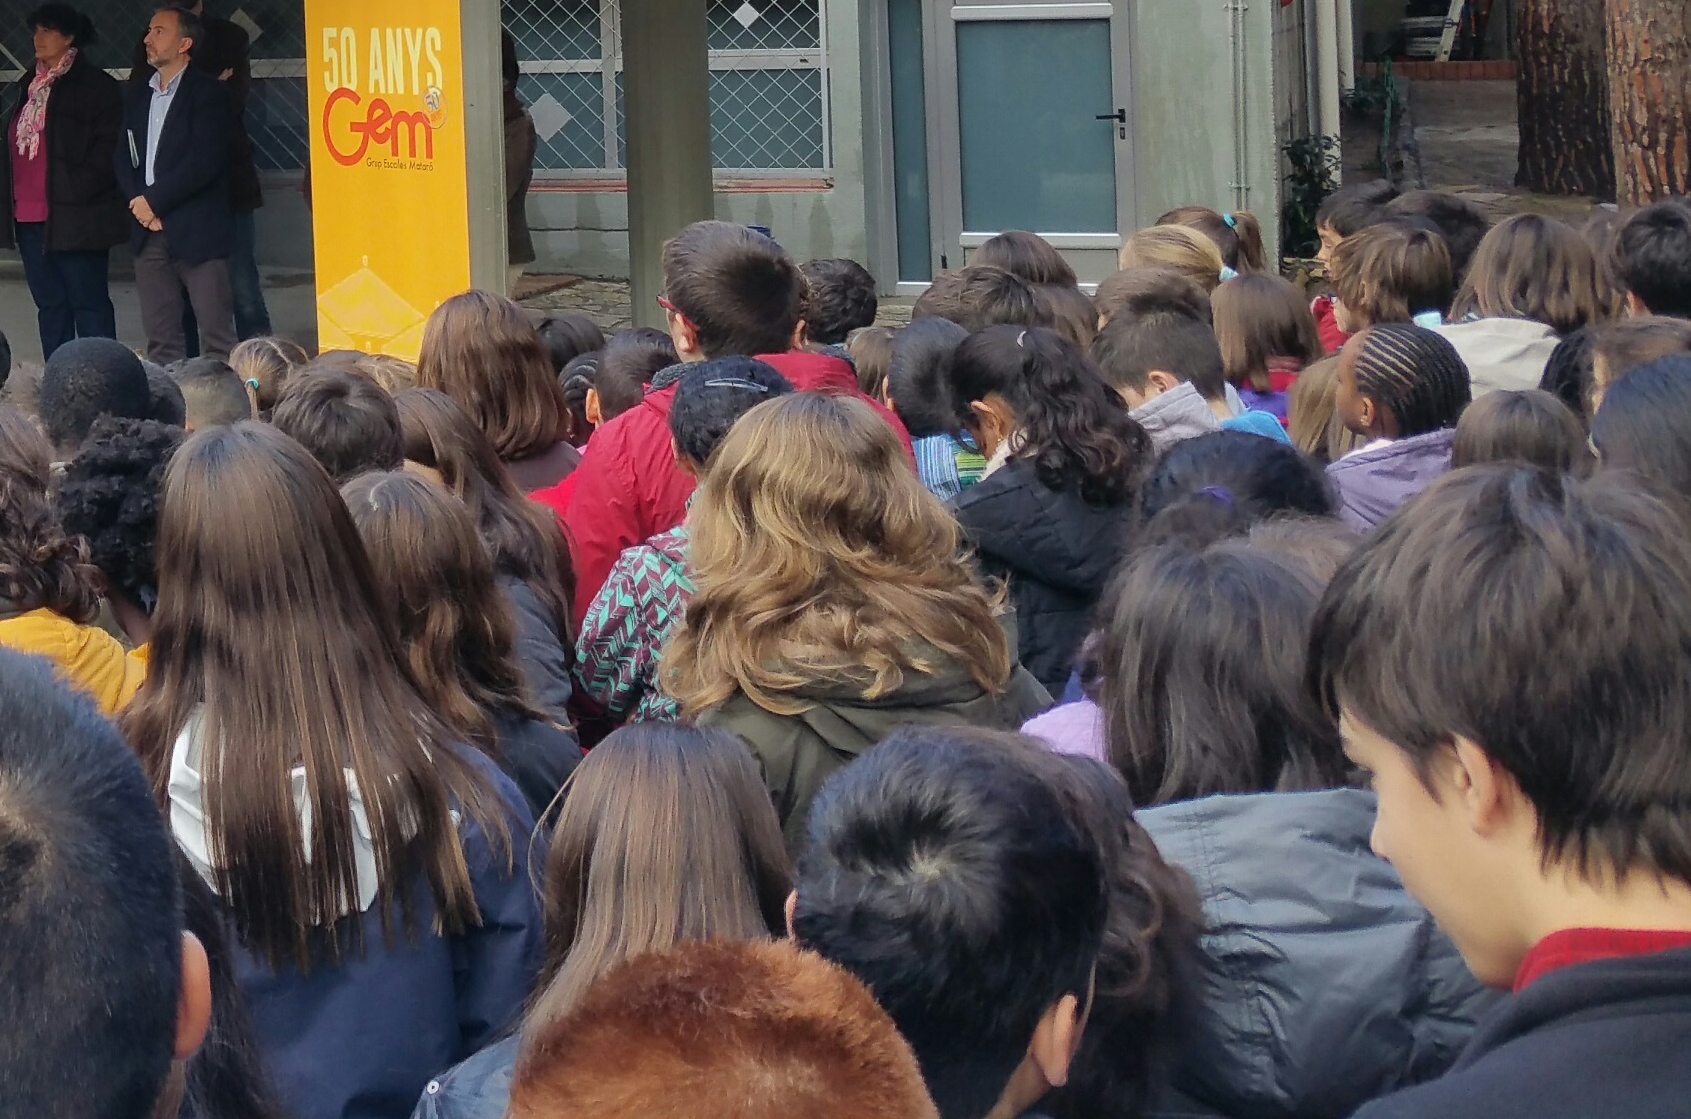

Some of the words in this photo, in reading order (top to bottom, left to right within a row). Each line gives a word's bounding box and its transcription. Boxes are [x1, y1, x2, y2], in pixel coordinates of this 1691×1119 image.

[323, 26, 359, 93] 50
[368, 26, 443, 96] ANYS
[322, 86, 434, 167] Gem
